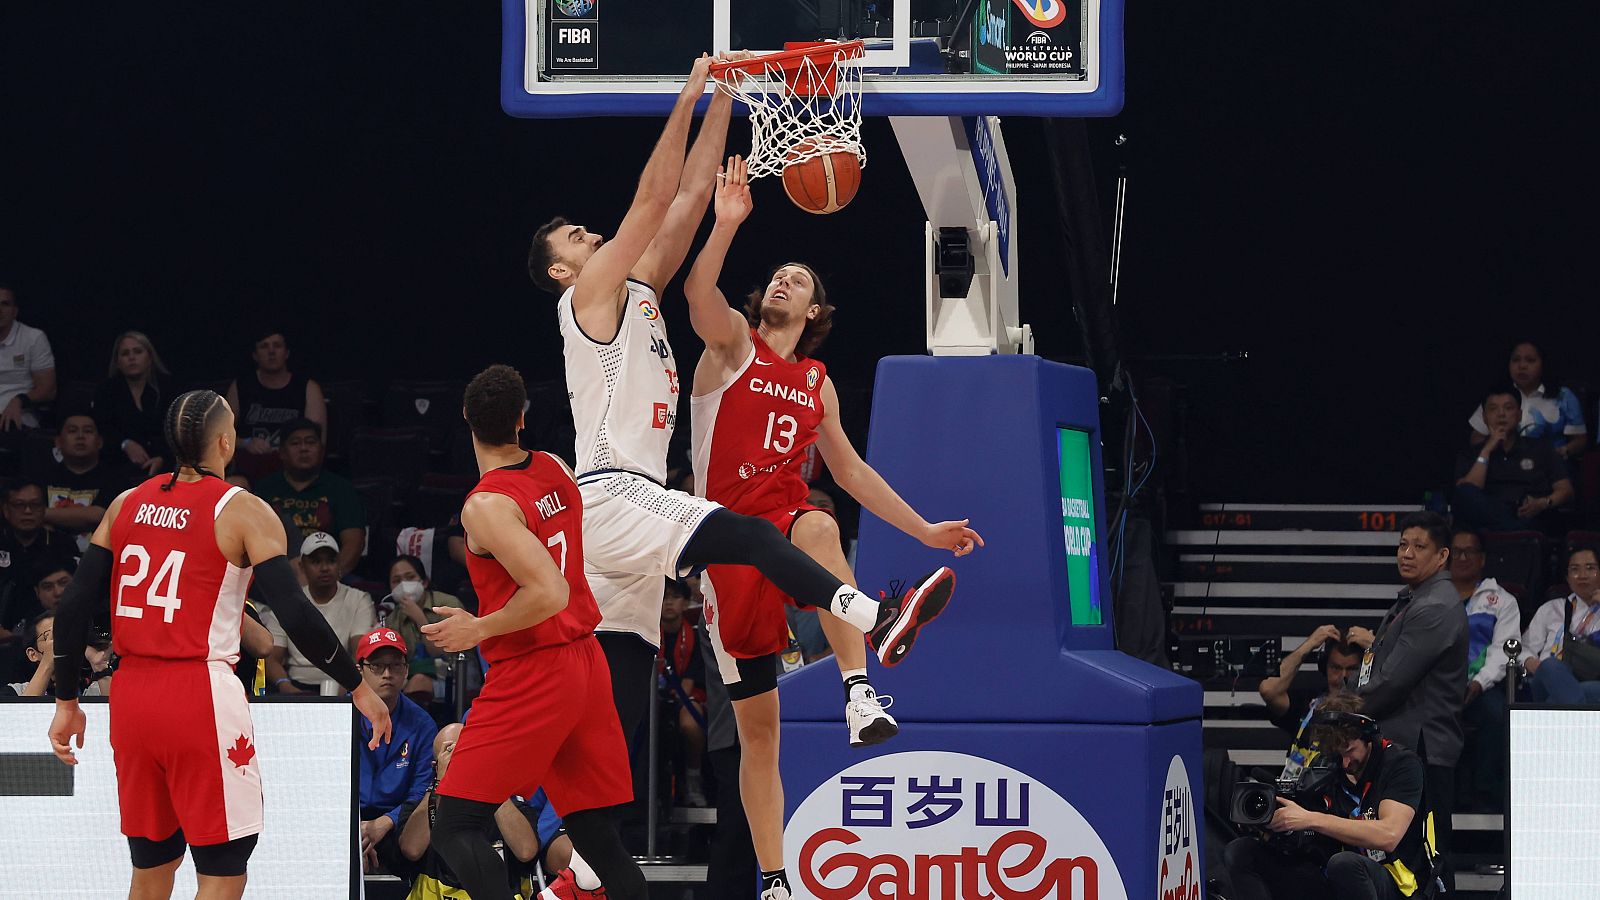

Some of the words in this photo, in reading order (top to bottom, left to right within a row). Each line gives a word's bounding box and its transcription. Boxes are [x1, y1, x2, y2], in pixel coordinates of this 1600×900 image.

[559, 28, 590, 43] FIBA
[1005, 52, 1046, 61] WORLD
[1050, 52, 1072, 61] CUP
[750, 378, 815, 411] CANADA
[764, 412, 797, 453] 13
[135, 503, 190, 529] BROOKS
[1359, 512, 1397, 529] 101
[547, 530, 568, 578] 7
[1080, 526, 1091, 556] CUP
[116, 544, 185, 623] 24
[842, 591, 858, 614] PEAK
[840, 775, 1029, 829] 百岁山
[1166, 785, 1190, 855] 百岁山
